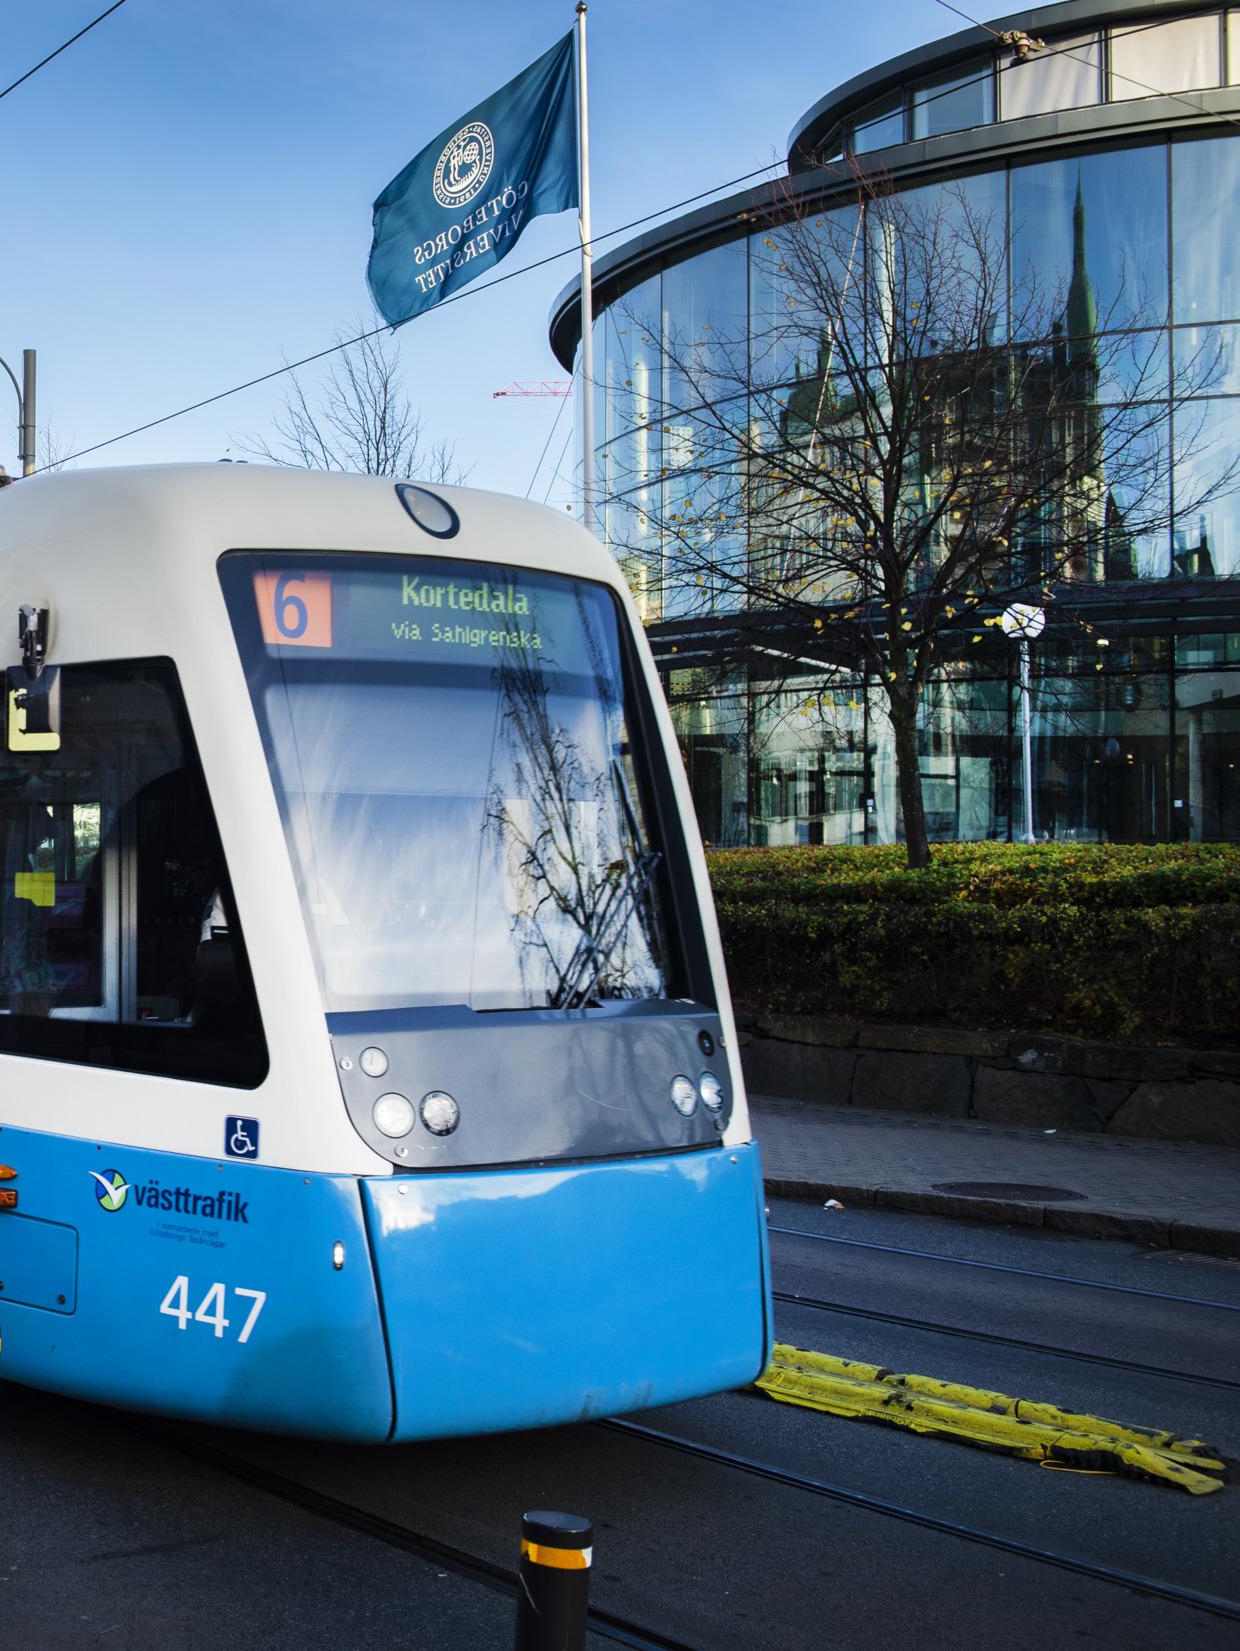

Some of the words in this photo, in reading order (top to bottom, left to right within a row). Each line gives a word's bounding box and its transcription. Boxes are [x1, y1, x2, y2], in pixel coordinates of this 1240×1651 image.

[273, 571, 308, 639] 6
[402, 575, 530, 615] Kortedala
[392, 621, 422, 641] via
[432, 623, 543, 649] Sahlgrenska
[133, 1180, 250, 1225] västtrafik
[160, 1275, 267, 1344] 447
